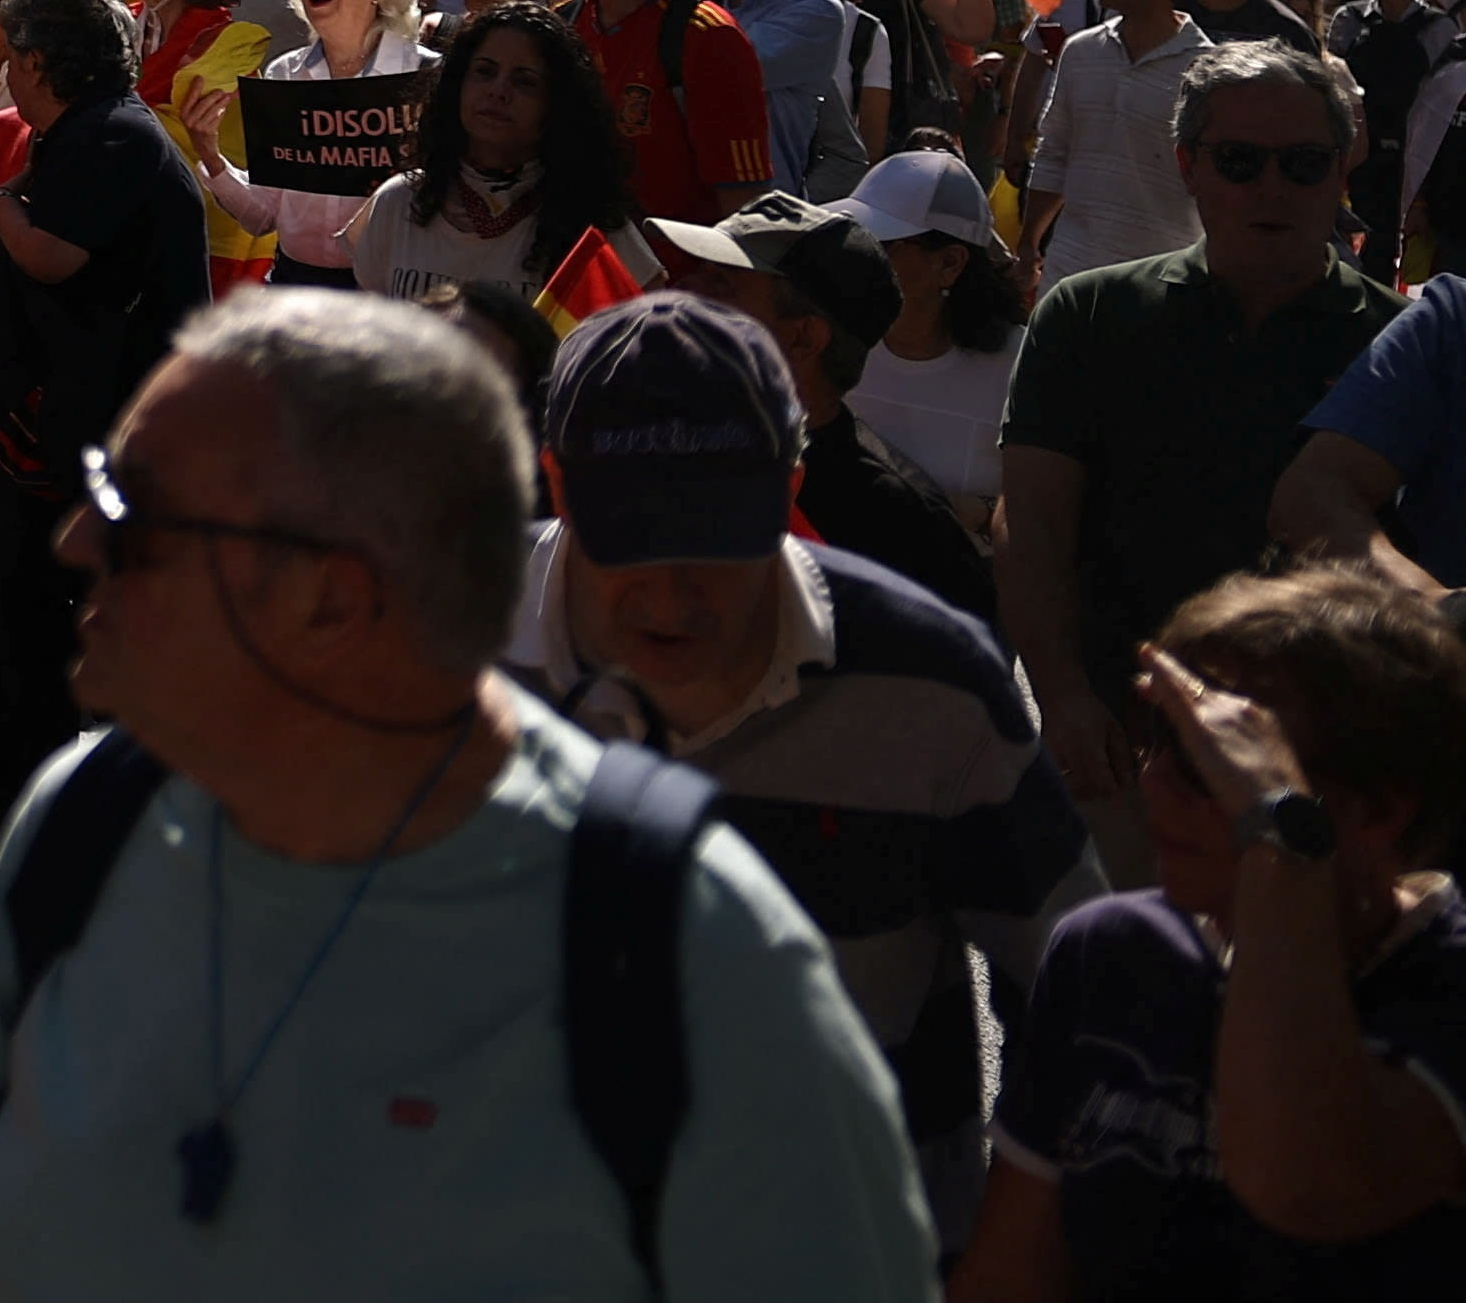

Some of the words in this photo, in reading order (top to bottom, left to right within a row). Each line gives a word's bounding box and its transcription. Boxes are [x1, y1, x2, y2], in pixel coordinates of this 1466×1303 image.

[273, 146, 296, 162] DE
[296, 150, 316, 164] LA
[320, 145, 394, 168] MAFIA
